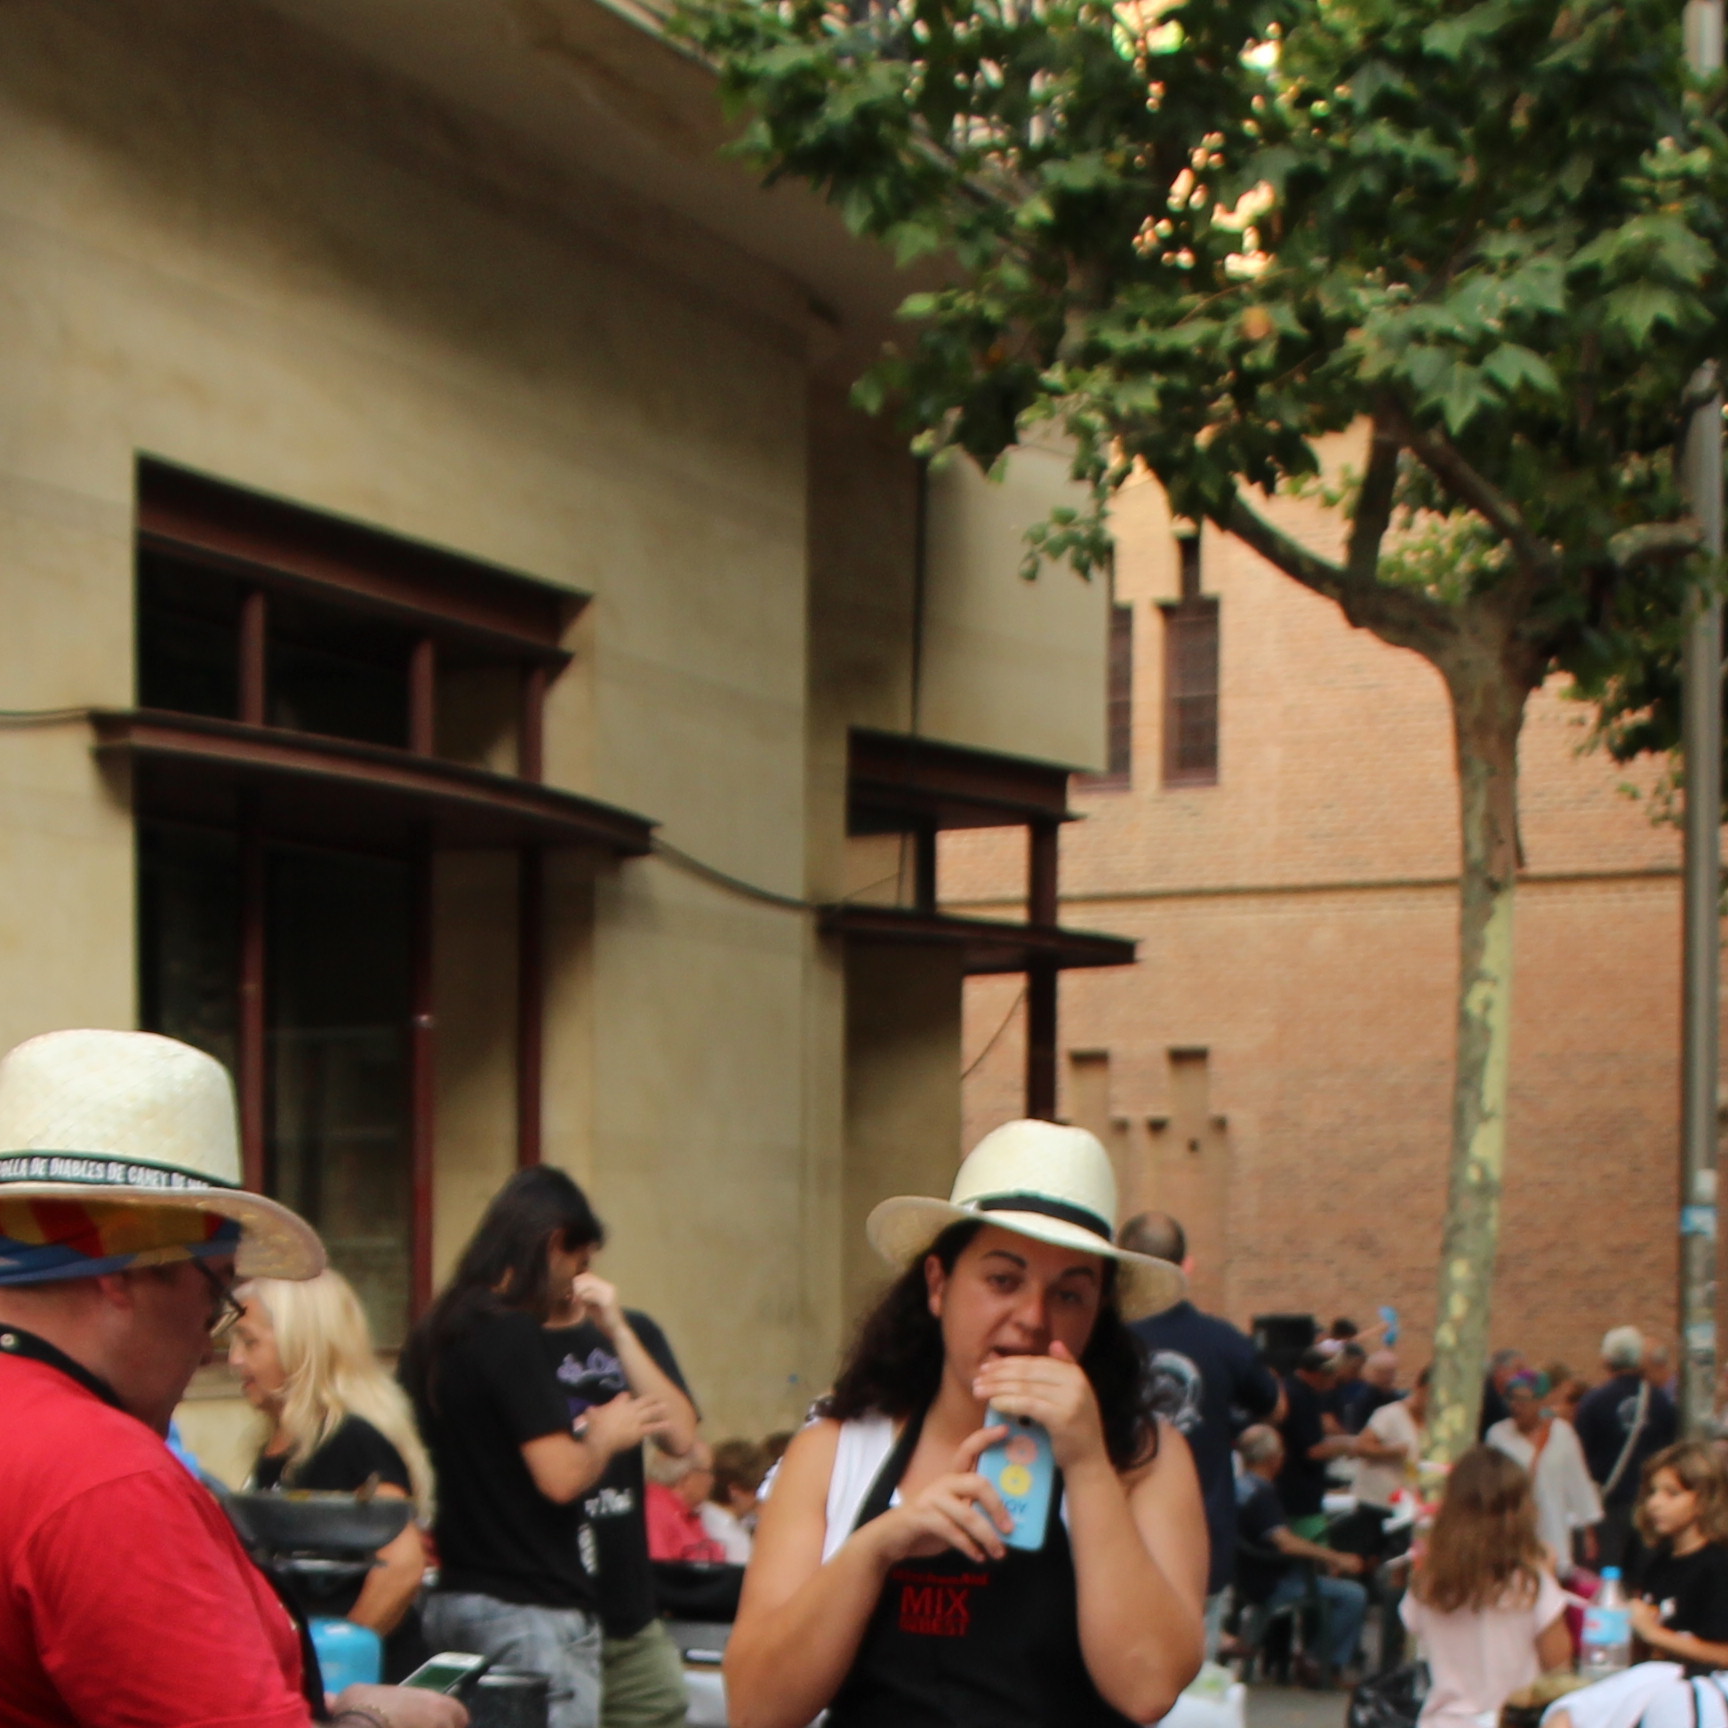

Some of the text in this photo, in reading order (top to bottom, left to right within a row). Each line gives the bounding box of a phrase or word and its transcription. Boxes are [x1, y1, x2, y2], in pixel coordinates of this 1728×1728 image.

[30, 1156, 48, 1176] DE
[49, 1157, 105, 1180] DIABLES
[107, 1162, 125, 1182] DE
[900, 1585, 970, 1617] MIX
